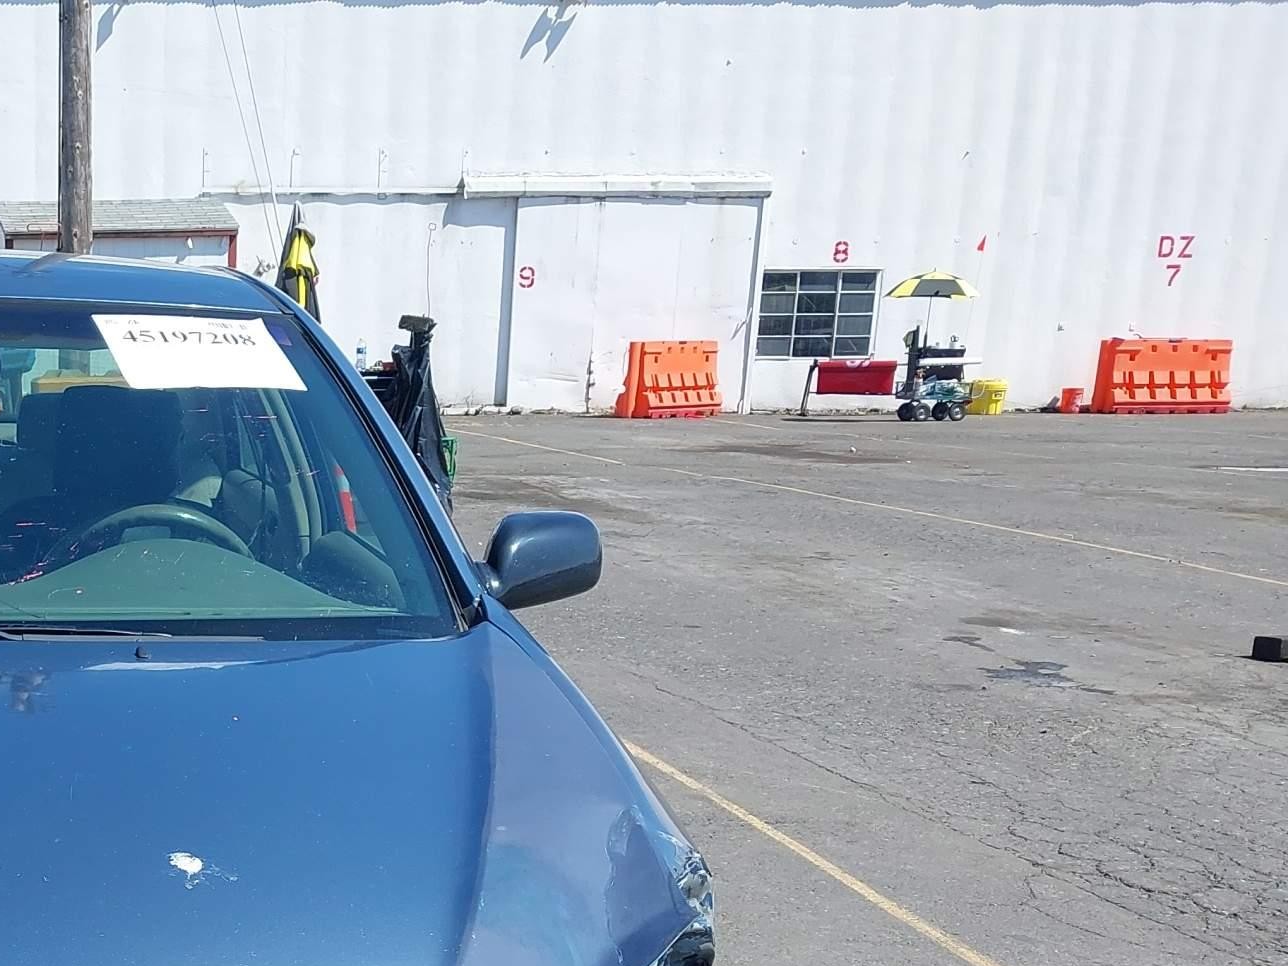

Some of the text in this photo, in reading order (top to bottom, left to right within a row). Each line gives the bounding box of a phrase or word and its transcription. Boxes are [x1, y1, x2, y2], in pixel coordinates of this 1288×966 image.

[832, 240, 849, 264] 8
[1158, 235, 1196, 259] DZ
[519, 265, 536, 289] 9
[1166, 263, 1182, 287] 7
[121, 329, 257, 346] 45197208
